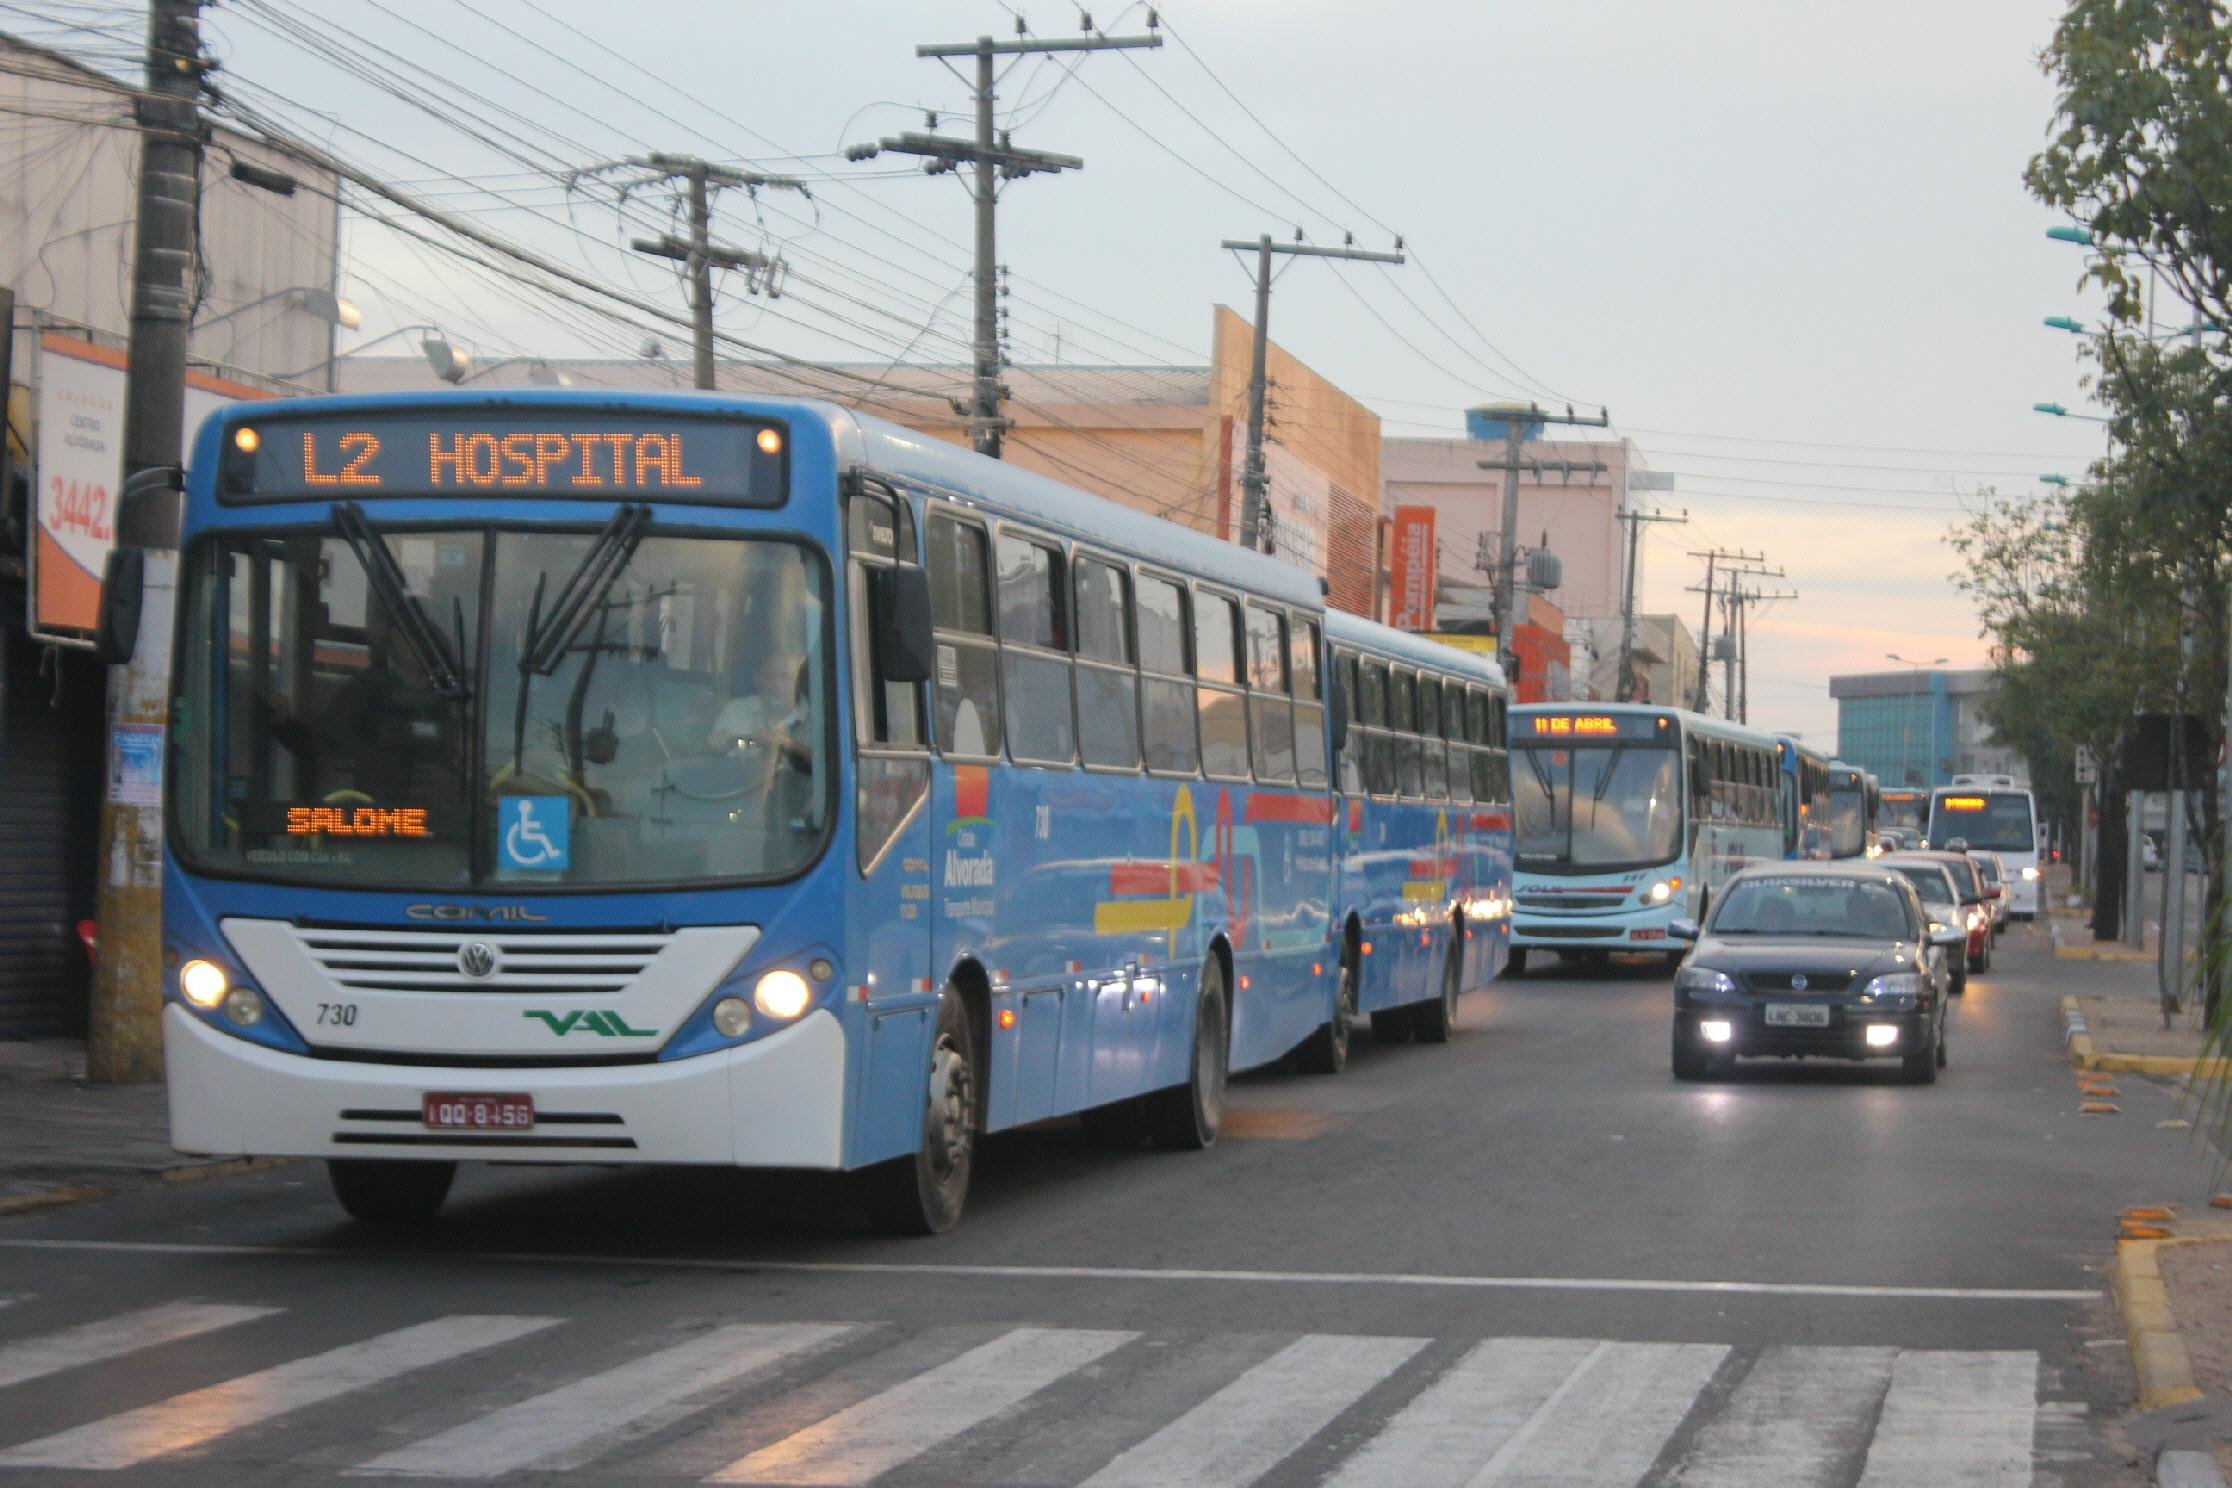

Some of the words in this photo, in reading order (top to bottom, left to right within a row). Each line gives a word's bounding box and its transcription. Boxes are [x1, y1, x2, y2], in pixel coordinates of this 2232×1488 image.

[303, 431, 381, 485] L2
[430, 431, 703, 486] HOSPITAL
[1551, 717, 1570, 733] DE
[287, 807, 428, 836] SALOME
[944, 849, 993, 886] Alvorada
[406, 904, 547, 921] COMIL
[316, 1004, 357, 1026] 730
